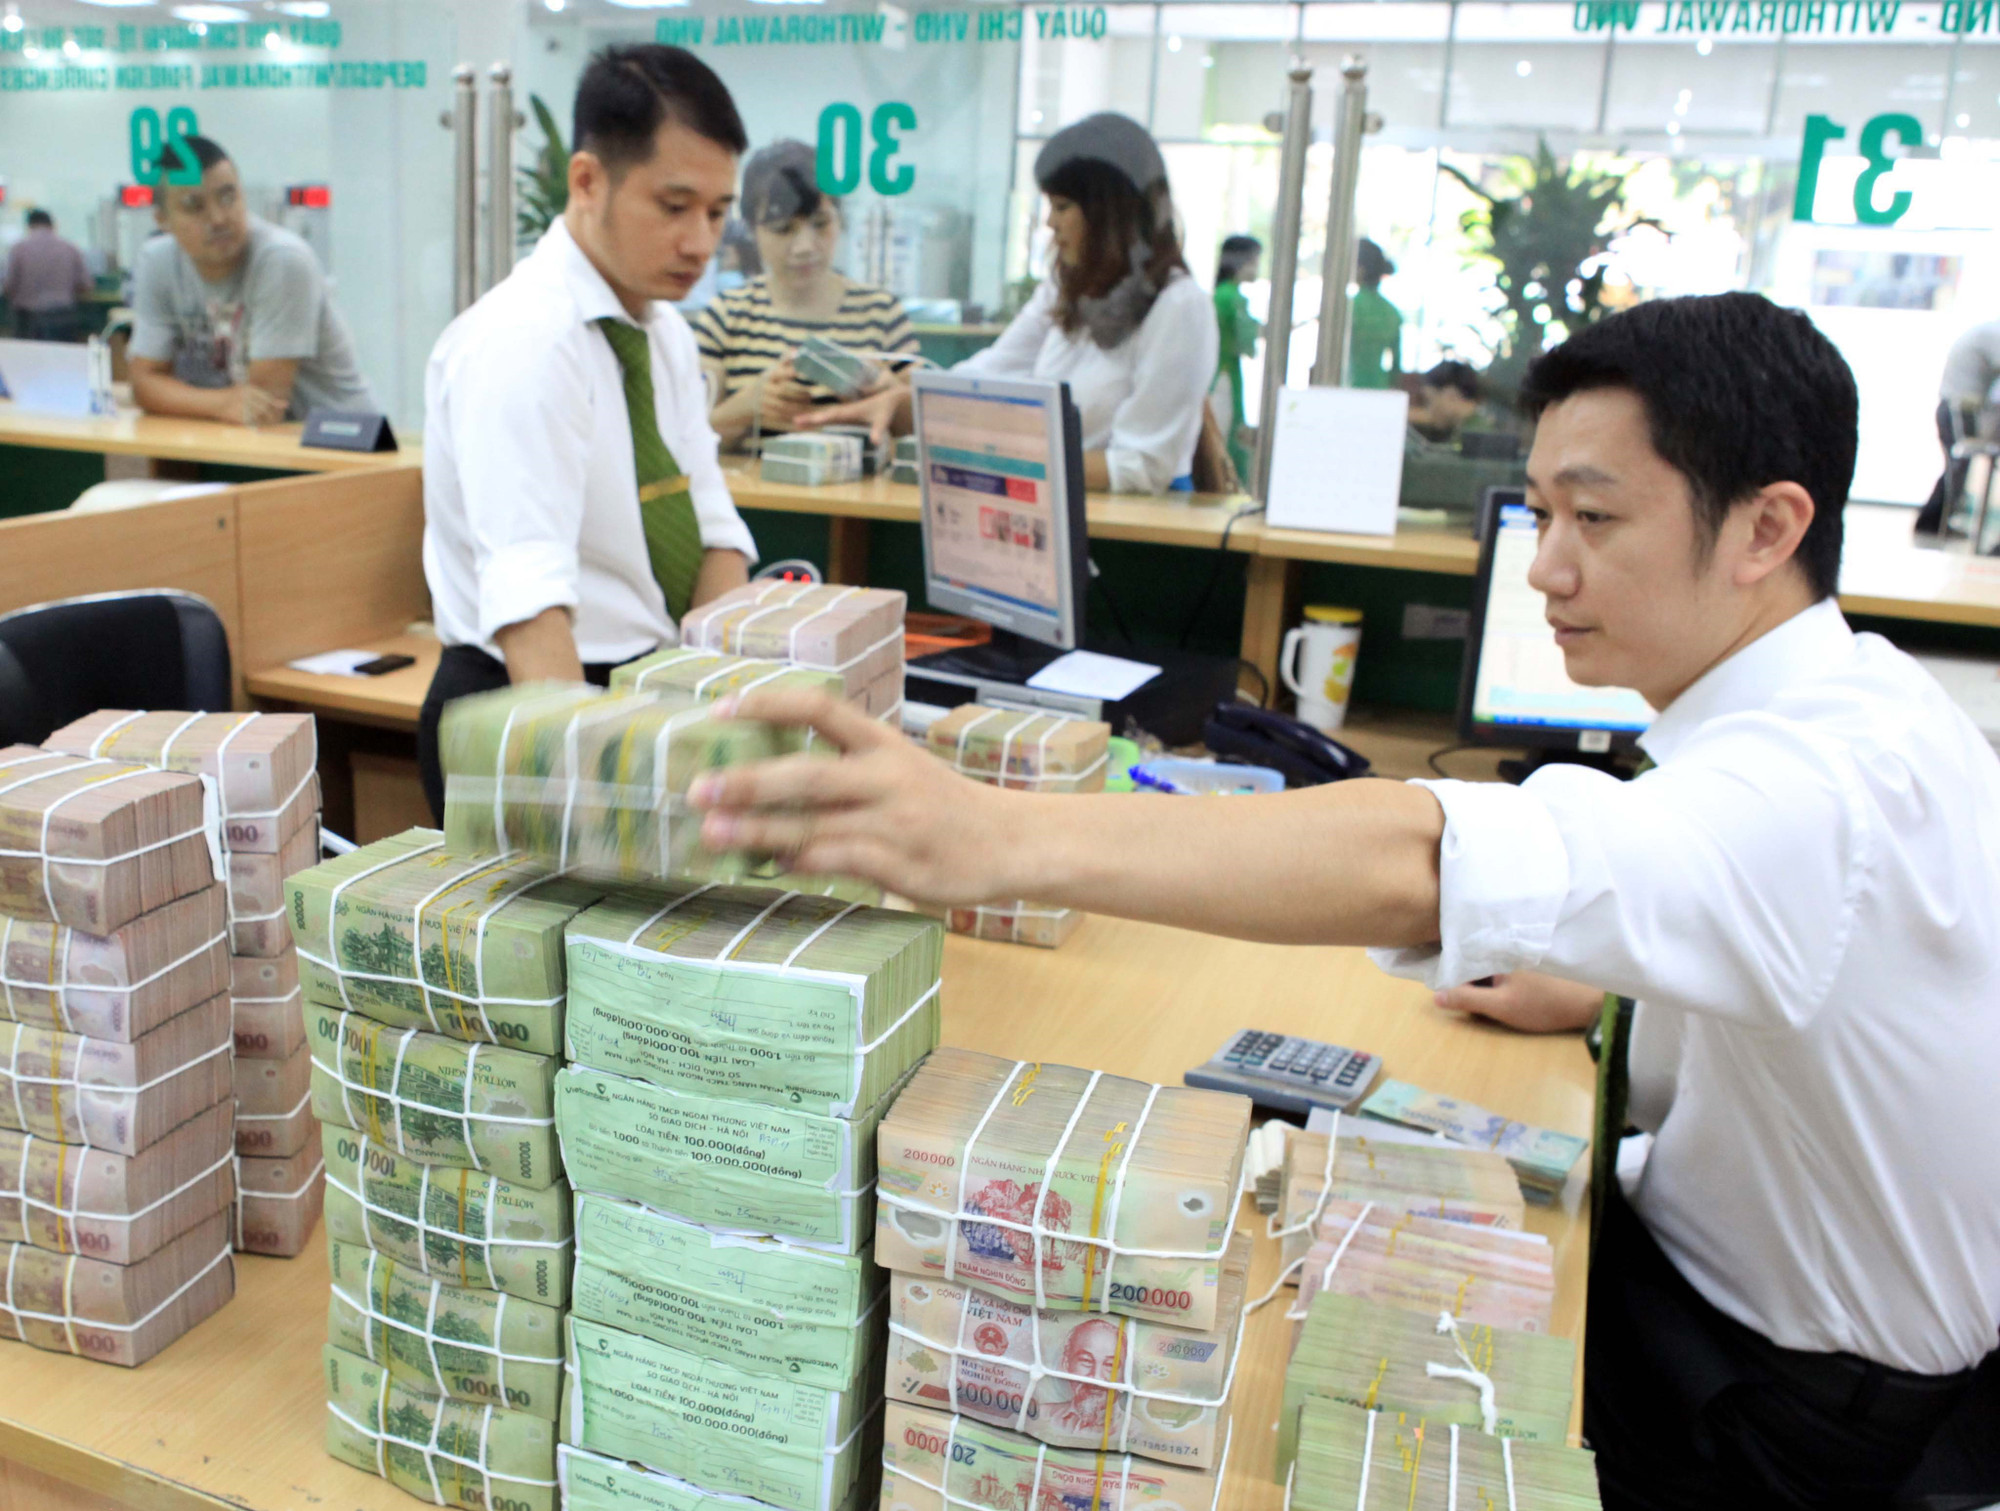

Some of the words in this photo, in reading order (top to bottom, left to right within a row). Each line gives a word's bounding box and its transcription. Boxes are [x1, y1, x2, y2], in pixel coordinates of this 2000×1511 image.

[750, 1047, 781, 1061] 1.000
[612, 1130, 641, 1146] 1.000
[903, 1146, 956, 1168] 200000
[1108, 1283, 1192, 1310] 200000
[1158, 1341, 1206, 1358] 200000
